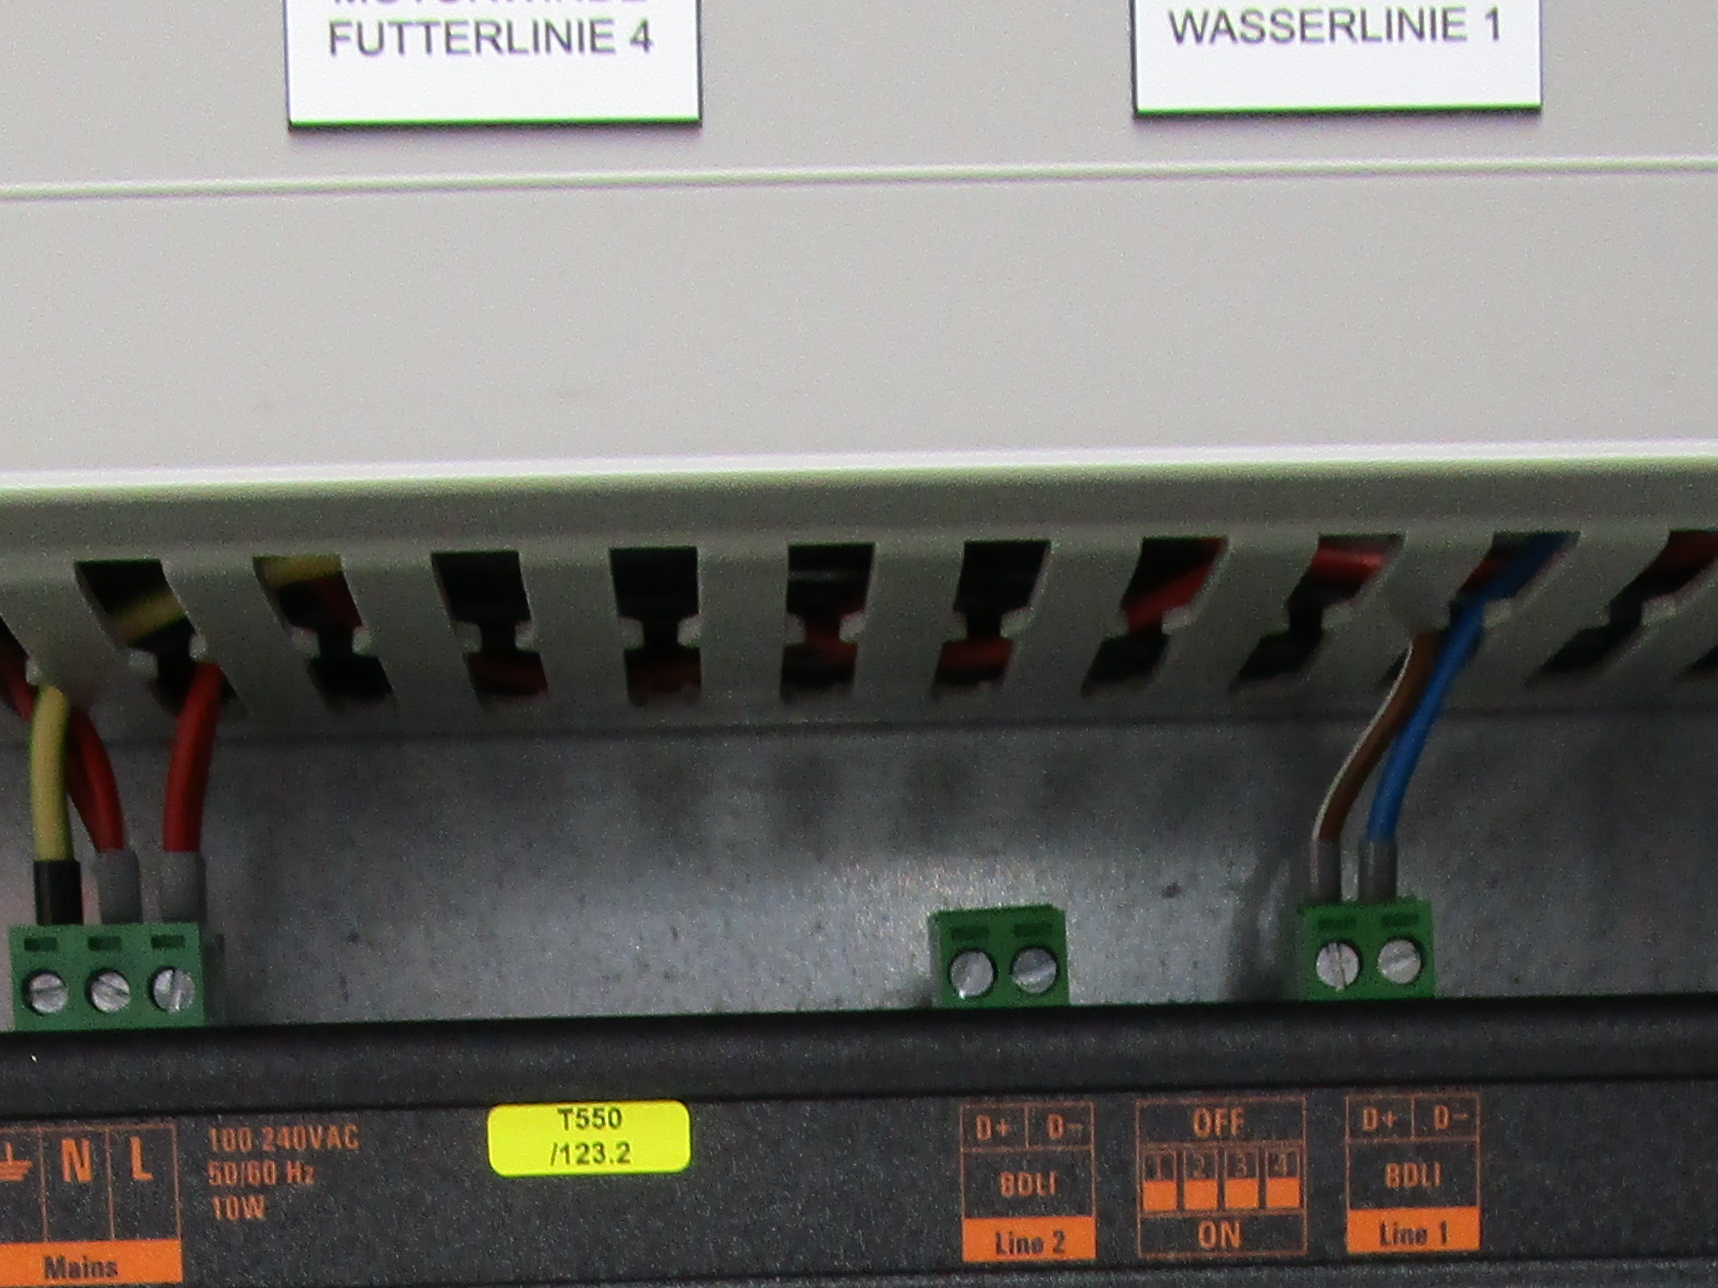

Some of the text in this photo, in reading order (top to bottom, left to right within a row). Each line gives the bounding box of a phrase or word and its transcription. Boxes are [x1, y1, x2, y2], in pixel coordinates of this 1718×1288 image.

[329, 18, 654, 56] FUTTERLINIE 4
[1169, 7, 1501, 44] WASSERLINIE 1
[557, 1107, 622, 1131] T550
[1193, 1108, 1245, 1137] OFF
[1362, 1107, 1397, 1132] D+
[61, 1136, 154, 1183] N L
[550, 1142, 631, 1168] /123.2
[208, 1160, 316, 1187] 50/60 Hz
[1000, 1172, 1056, 1197] BDLI
[1385, 1162, 1442, 1188] BDLI
[212, 1195, 266, 1221] 10W
[995, 1230, 1067, 1256] Line 2
[1198, 1222, 1242, 1249] ON
[1380, 1221, 1449, 1247] Line 1
[43, 1252, 118, 1280] Mains
